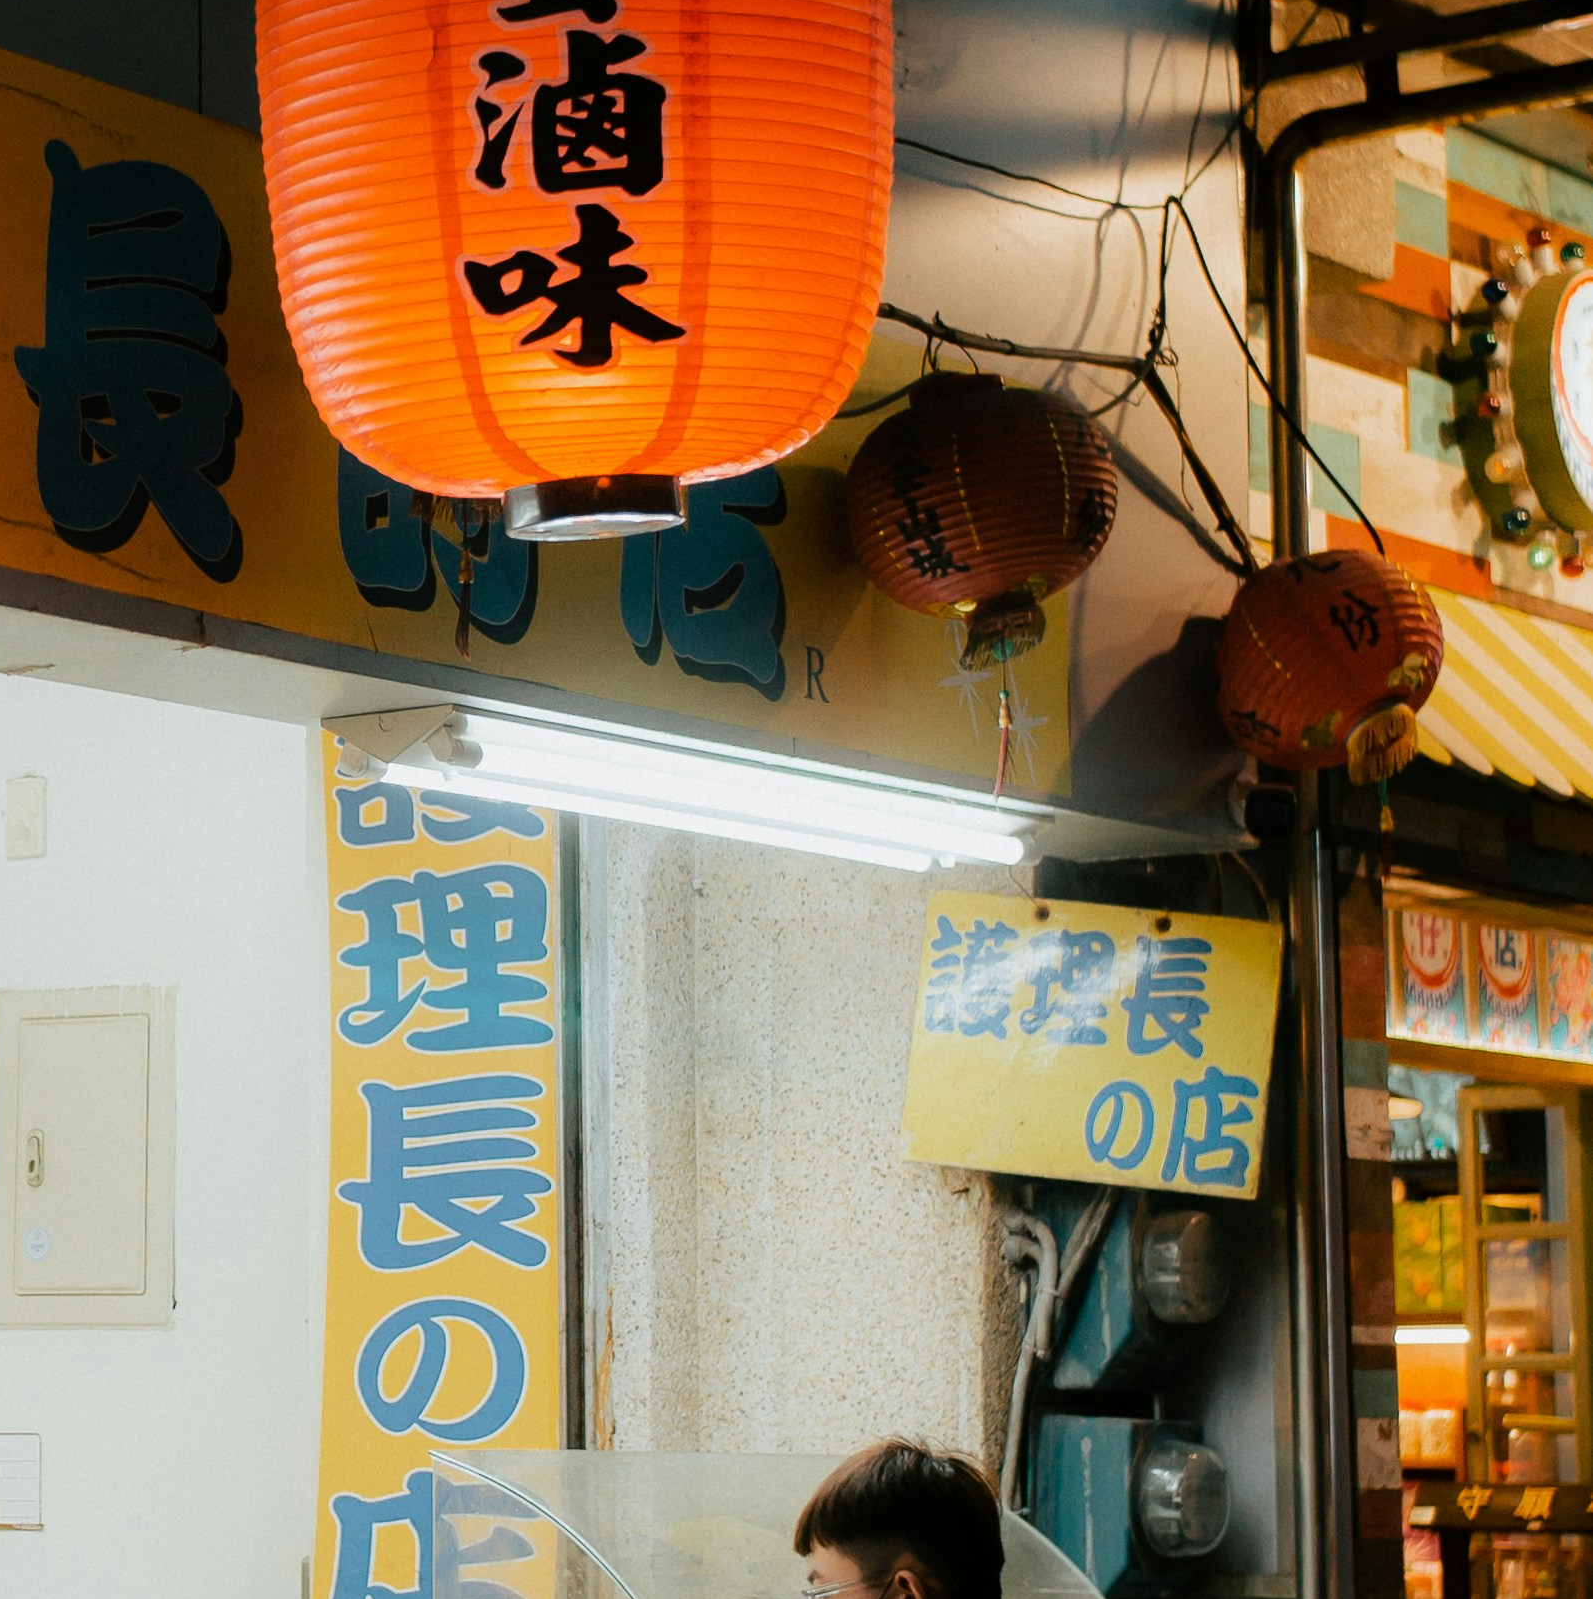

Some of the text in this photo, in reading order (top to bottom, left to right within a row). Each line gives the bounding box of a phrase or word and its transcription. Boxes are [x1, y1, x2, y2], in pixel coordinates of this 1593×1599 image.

[922, 913, 1213, 1061] 護理長
[1083, 1065, 1260, 1189] の店
